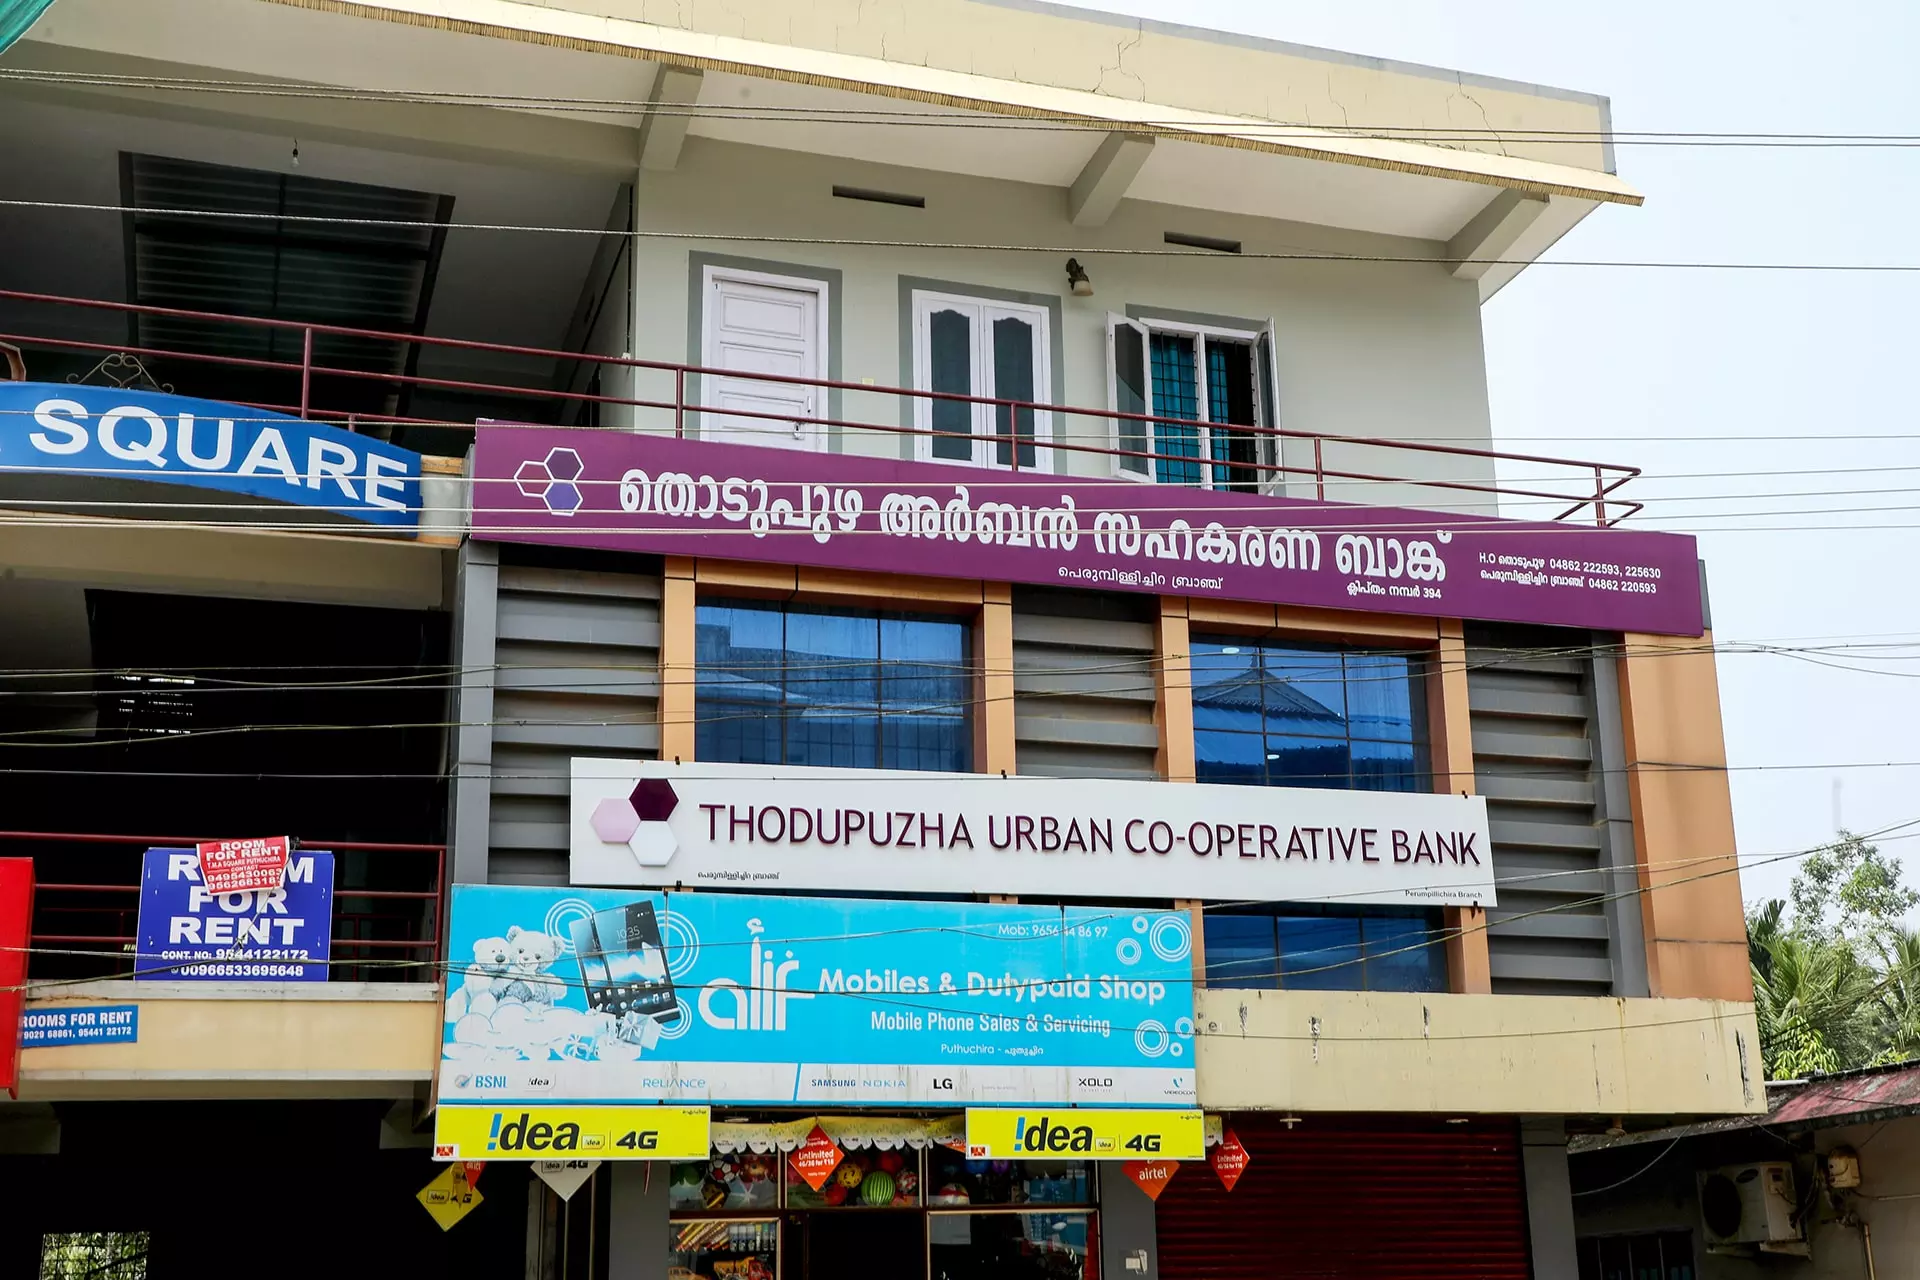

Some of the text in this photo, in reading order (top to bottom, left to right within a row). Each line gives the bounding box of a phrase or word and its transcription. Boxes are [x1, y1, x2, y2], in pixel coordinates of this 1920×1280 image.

[28, 398, 407, 513] SQUARE
[619, 468, 1452, 582] തൊടുപുഴ അർബൻ സഹകരണ ബാങ്ക്
[1549, 558, 1581, 572] 04862
[1583, 561, 1622, 577] 222593,
[1625, 566, 1661, 579] 225630
[1423, 587, 1442, 599] 394
[1588, 577, 1619, 591] 04862
[1621, 581, 1657, 594] 220593
[698, 803, 1481, 866] THODUPUZHA URBAN CO-OPERATIVE BANK
[220, 840, 265, 851] ROOM
[206, 846, 281, 861] FOR RENT
[168, 854, 314, 884] RM
[231, 864, 258, 872] CONTACT
[188, 886, 289, 914] FOR
[1459, 891, 1483, 899] Branch
[169, 916, 305, 945] RENT
[998, 924, 1029, 936] Mob:
[1078, 926, 1092, 937] 86
[1094, 926, 1108, 937] 97
[819, 968, 1165, 1005] Mobiles & Dutypaid Shop
[70, 1012, 96, 1026] FOR
[100, 1011, 132, 1025] RENT
[871, 1011, 1110, 1037] Mobile Phone Sales & Servicing
[106, 1026, 132, 1036] 22172
[941, 1044, 995, 1054] Puthuchira
[811, 1078, 906, 1087] SAMSUNG NOKIA
[933, 1078, 953, 1090] LG
[1079, 1078, 1113, 1087] XOLO
[616, 1130, 658, 1150] 4G
[1125, 1134, 1161, 1152] 4G
[1139, 1167, 1167, 1180] airtel
